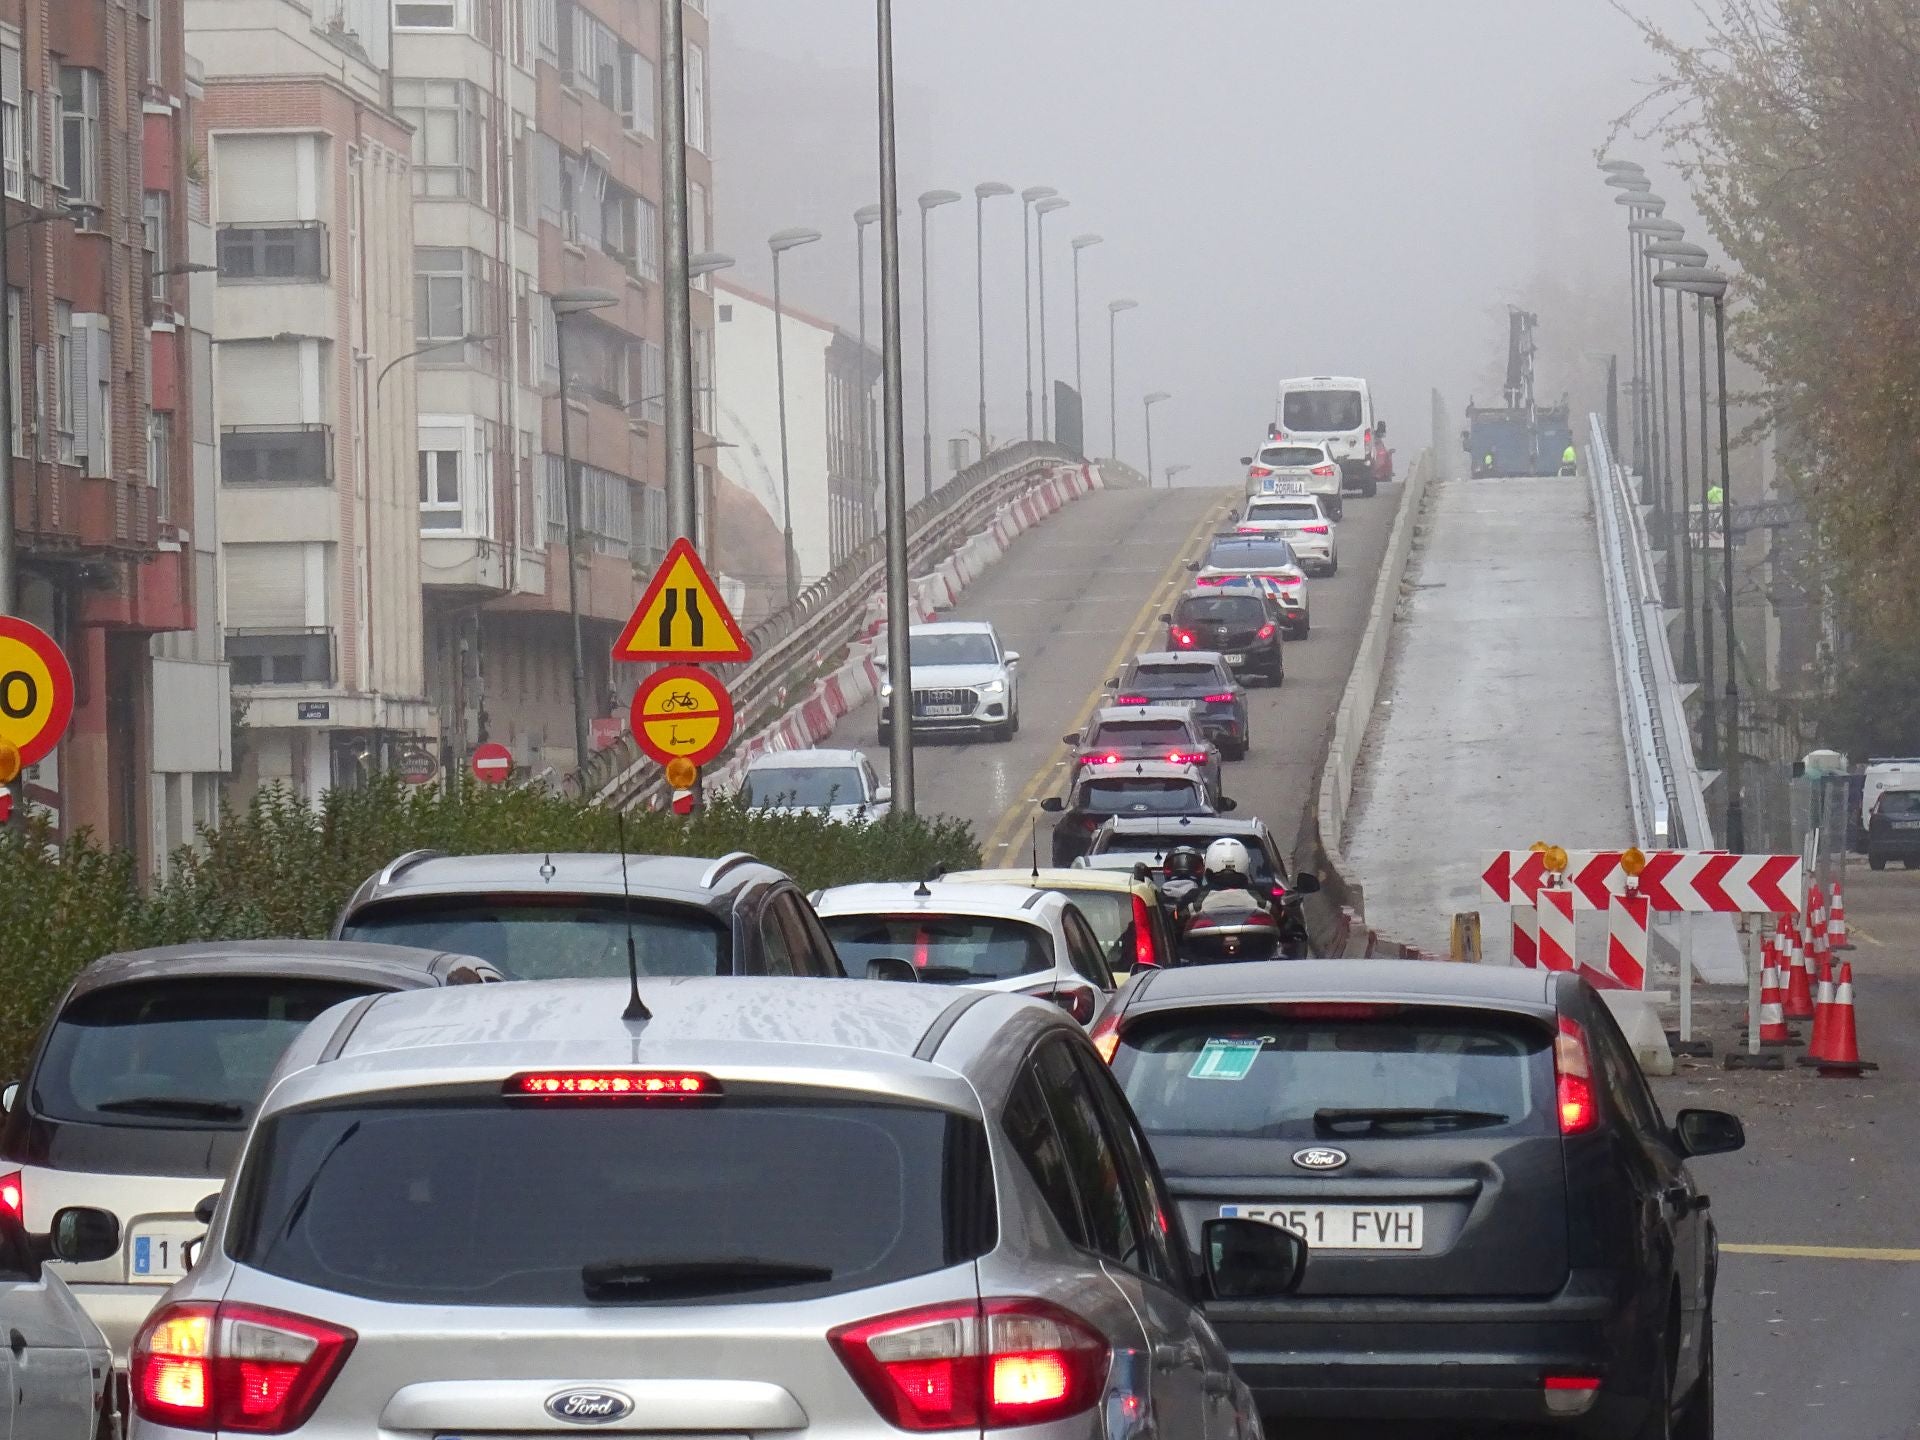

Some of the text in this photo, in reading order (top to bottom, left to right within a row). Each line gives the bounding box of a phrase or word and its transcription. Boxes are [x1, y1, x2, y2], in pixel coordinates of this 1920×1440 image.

[1305, 1151, 1334, 1165] Ford
[1352, 1212, 1413, 1243] FVH
[564, 1394, 612, 1415] Ford
